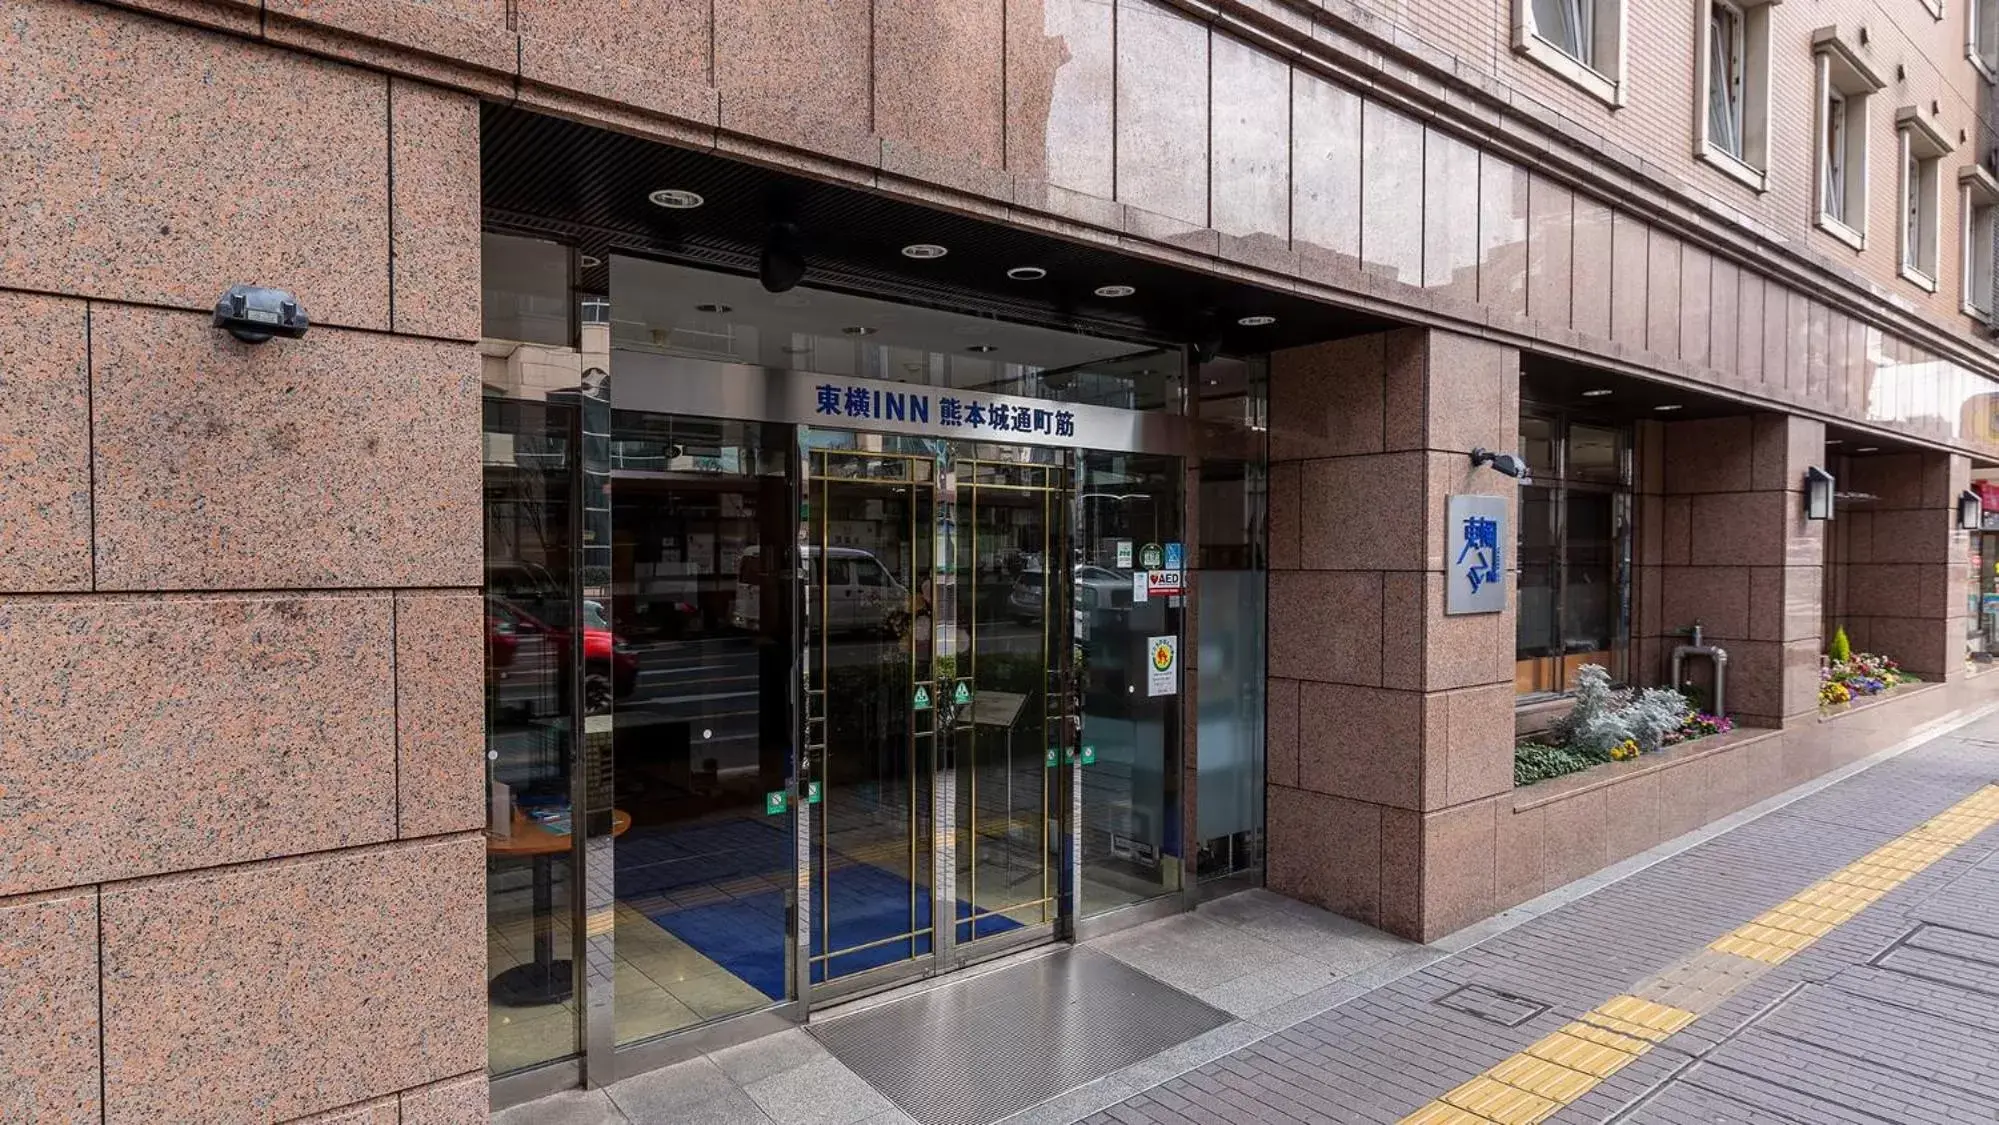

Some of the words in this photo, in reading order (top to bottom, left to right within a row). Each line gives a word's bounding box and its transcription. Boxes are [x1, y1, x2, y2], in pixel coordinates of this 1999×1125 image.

[815, 384, 929, 423] 東横INN
[939, 397, 1075, 437] 熊本城通町筋
[1158, 573, 1179, 584] AED
